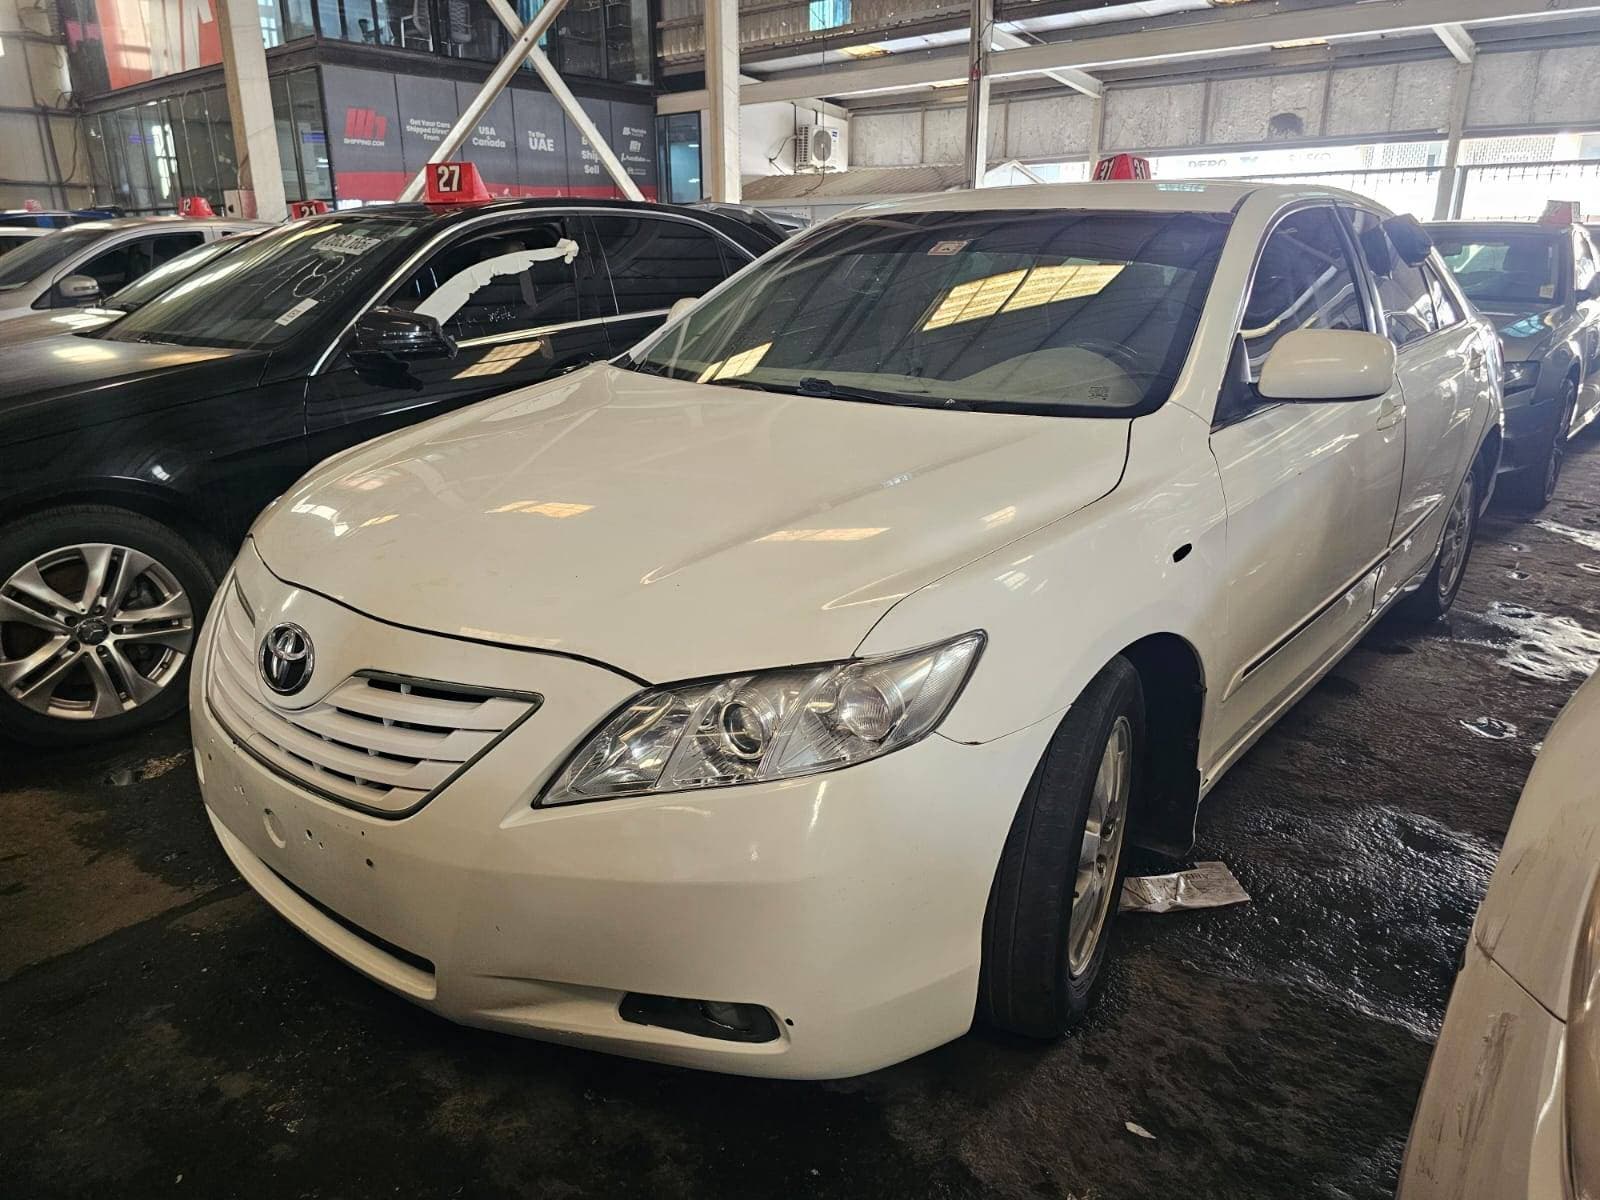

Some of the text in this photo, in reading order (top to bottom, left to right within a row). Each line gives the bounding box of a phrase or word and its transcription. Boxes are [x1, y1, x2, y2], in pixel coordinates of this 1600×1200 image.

[478, 126, 496, 136] USA
[472, 137, 506, 148] Canada
[528, 137, 555, 151] UAE
[584, 164, 600, 174] Sell
[437, 165, 460, 192] 27
[301, 205, 316, 217] 21
